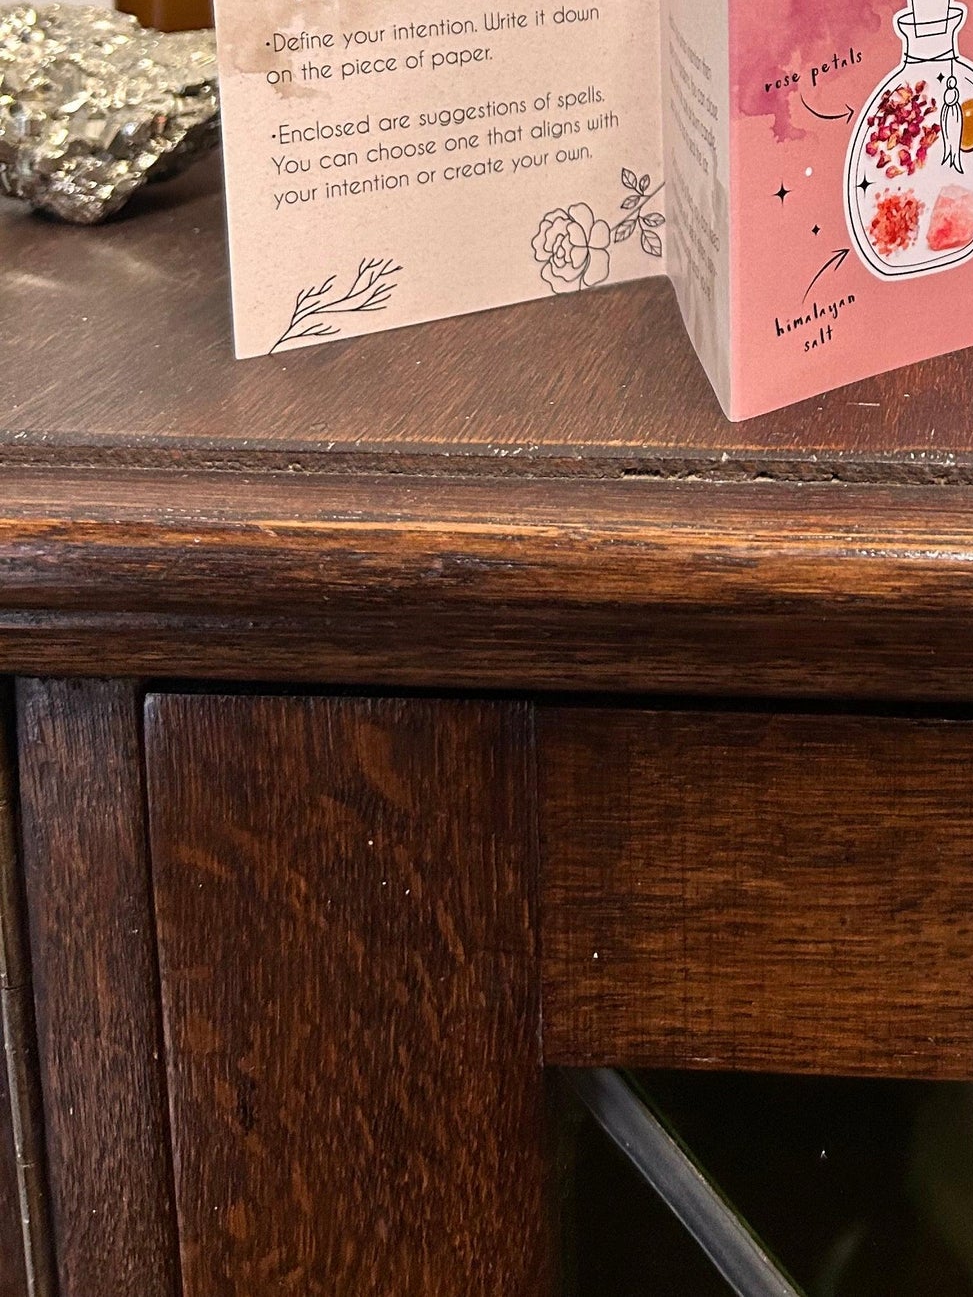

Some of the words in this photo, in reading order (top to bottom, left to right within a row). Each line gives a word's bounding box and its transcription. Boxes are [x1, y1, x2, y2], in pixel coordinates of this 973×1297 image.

[342, 25, 385, 49] your
[393, 19, 477, 40] intention.
[484, 12, 528, 31] Write
[536, 9, 545, 26] it
[553, 6, 599, 24] down
[265, 67, 292, 85] on
[301, 61, 332, 80] the
[342, 58, 397, 80] piece
[405, 51, 425, 69] of
[432, 48, 493, 70] paper.
[762, 73, 800, 96] rose
[811, 47, 861, 87] petals
[379, 115, 410, 131] are
[419, 101, 526, 126] suggestions
[534, 92, 551, 111] of
[558, 85, 605, 110] spells.
[271, 155, 310, 175] You
[320, 152, 357, 169] can
[367, 141, 437, 162] choose
[445, 135, 479, 151] one
[487, 125, 522, 146] that
[530, 120, 580, 139] aligns
[588, 110, 618, 132] with
[274, 188, 318, 210] your
[325, 174, 409, 198] intention
[417, 170, 436, 184] or
[444, 158, 504, 180] create
[512, 153, 549, 174] your
[555, 147, 592, 163] own.
[775, 295, 855, 337] himalayan
[804, 324, 833, 352] salt
